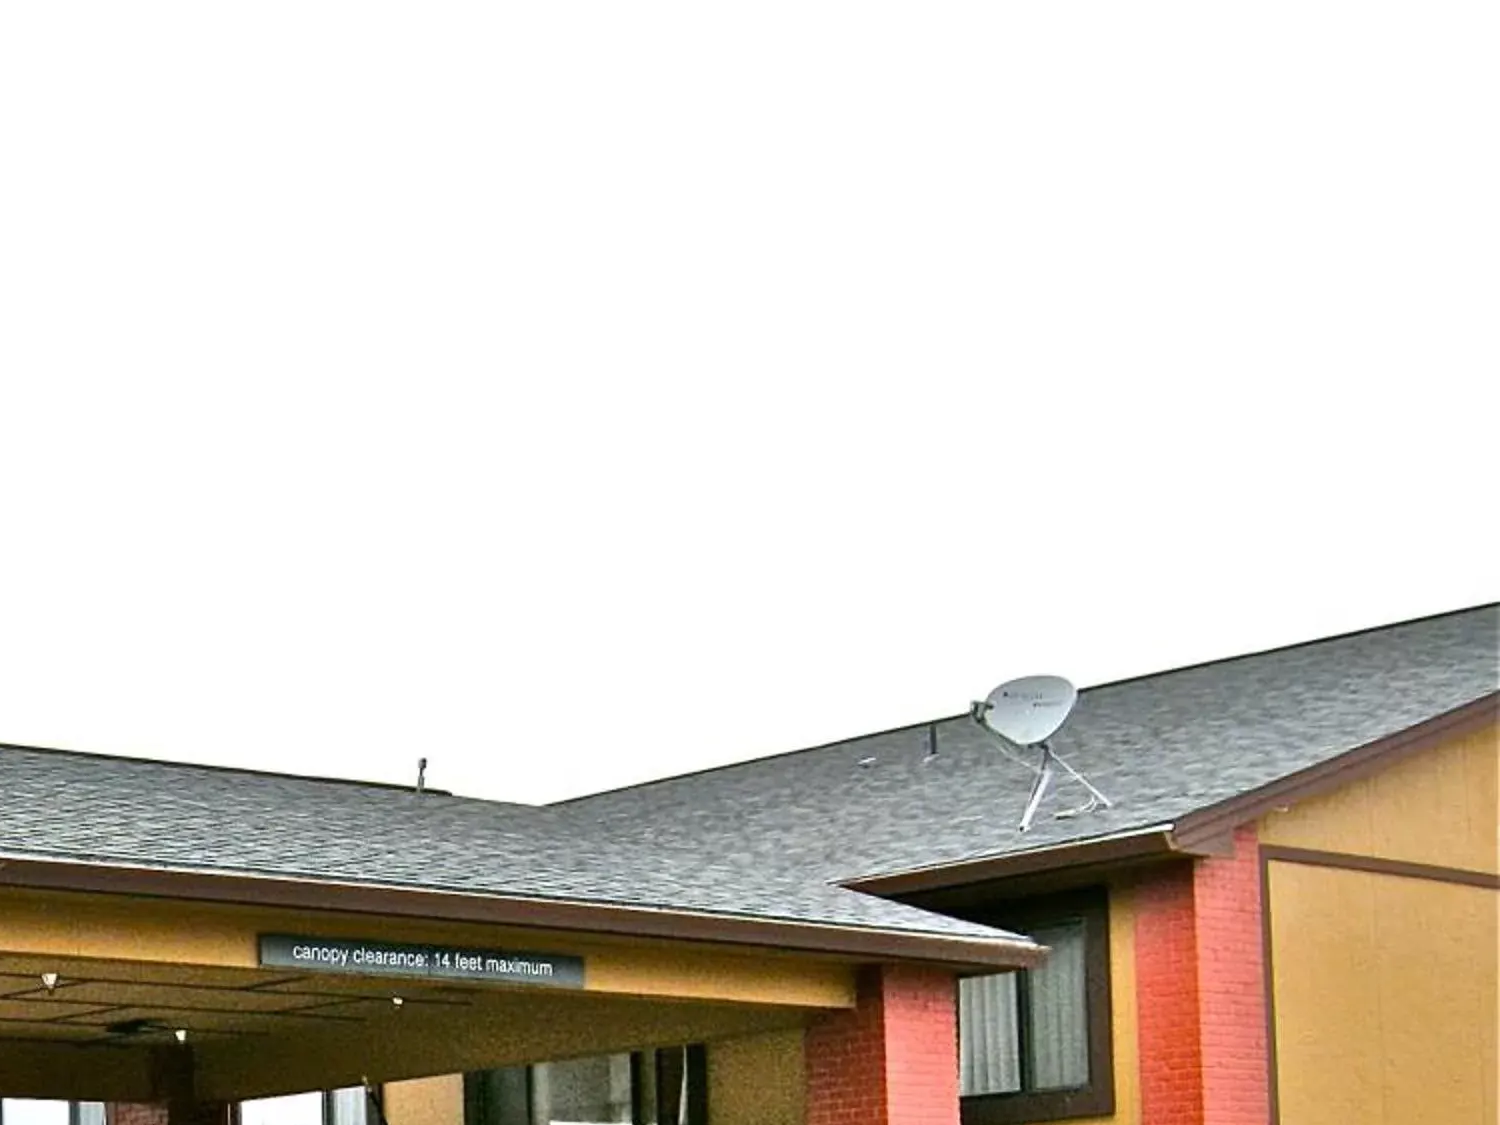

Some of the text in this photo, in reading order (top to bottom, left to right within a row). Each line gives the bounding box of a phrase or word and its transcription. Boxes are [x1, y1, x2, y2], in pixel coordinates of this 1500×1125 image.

[293, 945, 553, 976] canopy clearance: 14 feet maximum
